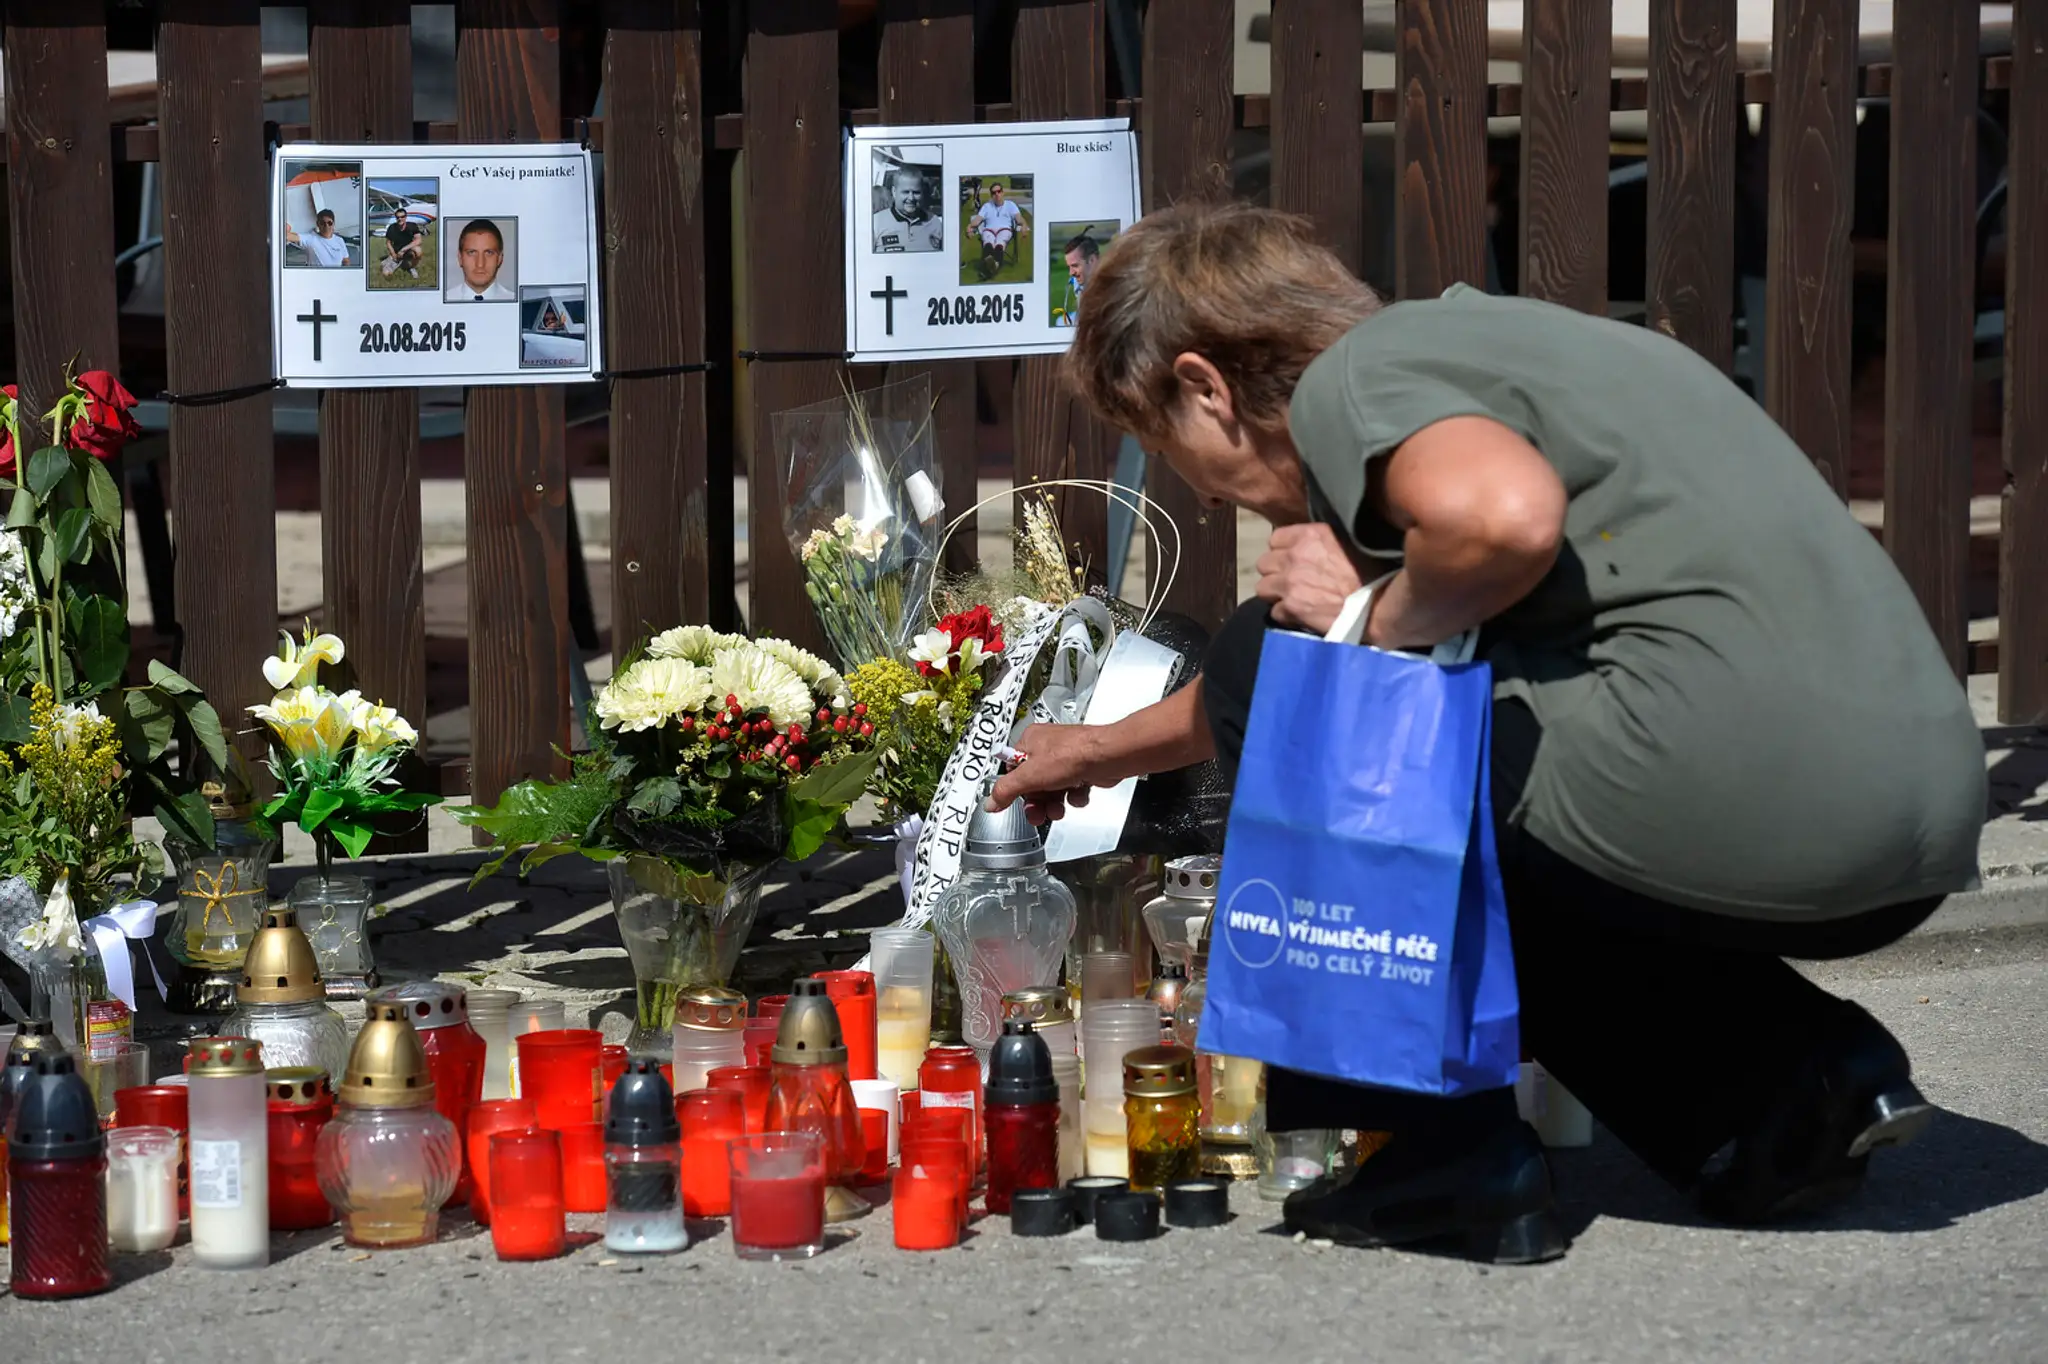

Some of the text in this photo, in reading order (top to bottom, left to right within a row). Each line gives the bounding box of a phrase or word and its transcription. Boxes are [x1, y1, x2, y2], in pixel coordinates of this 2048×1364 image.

[1057, 140, 1113, 153] Blue skies!
[482, 166, 515, 181] Vašej
[519, 165, 575, 180] pamiatke!
[927, 294, 1024, 325] 20.08.2015
[360, 323, 466, 352] 20.08.2015
[963, 701, 1003, 781] ROBKO
[1230, 909, 1281, 937] NIVEA
[1292, 897, 1355, 923] 100 LET
[1288, 918, 1439, 962] VÝJIMEČNÉ PÉČE
[1286, 948, 1435, 987] PRO CELÝ ŽIVOT
